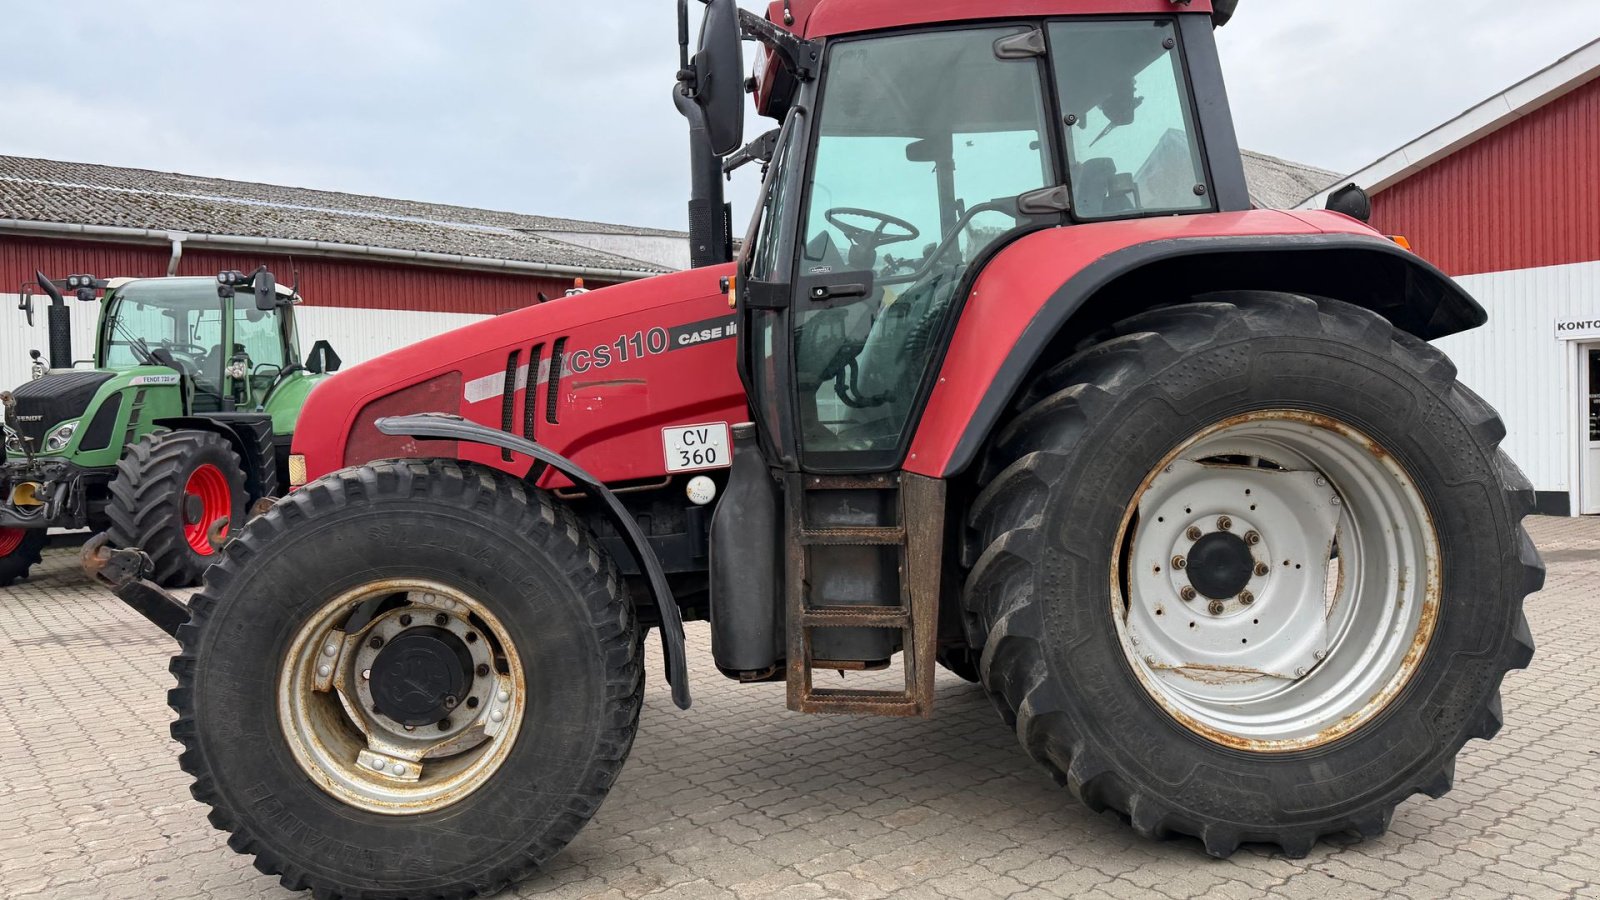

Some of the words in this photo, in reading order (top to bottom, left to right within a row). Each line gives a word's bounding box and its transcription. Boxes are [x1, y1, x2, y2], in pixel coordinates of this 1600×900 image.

[1557, 320, 1600, 331] KONTO
[678, 326, 722, 345] CASE
[682, 428, 709, 447] CV
[679, 447, 717, 468] 360
